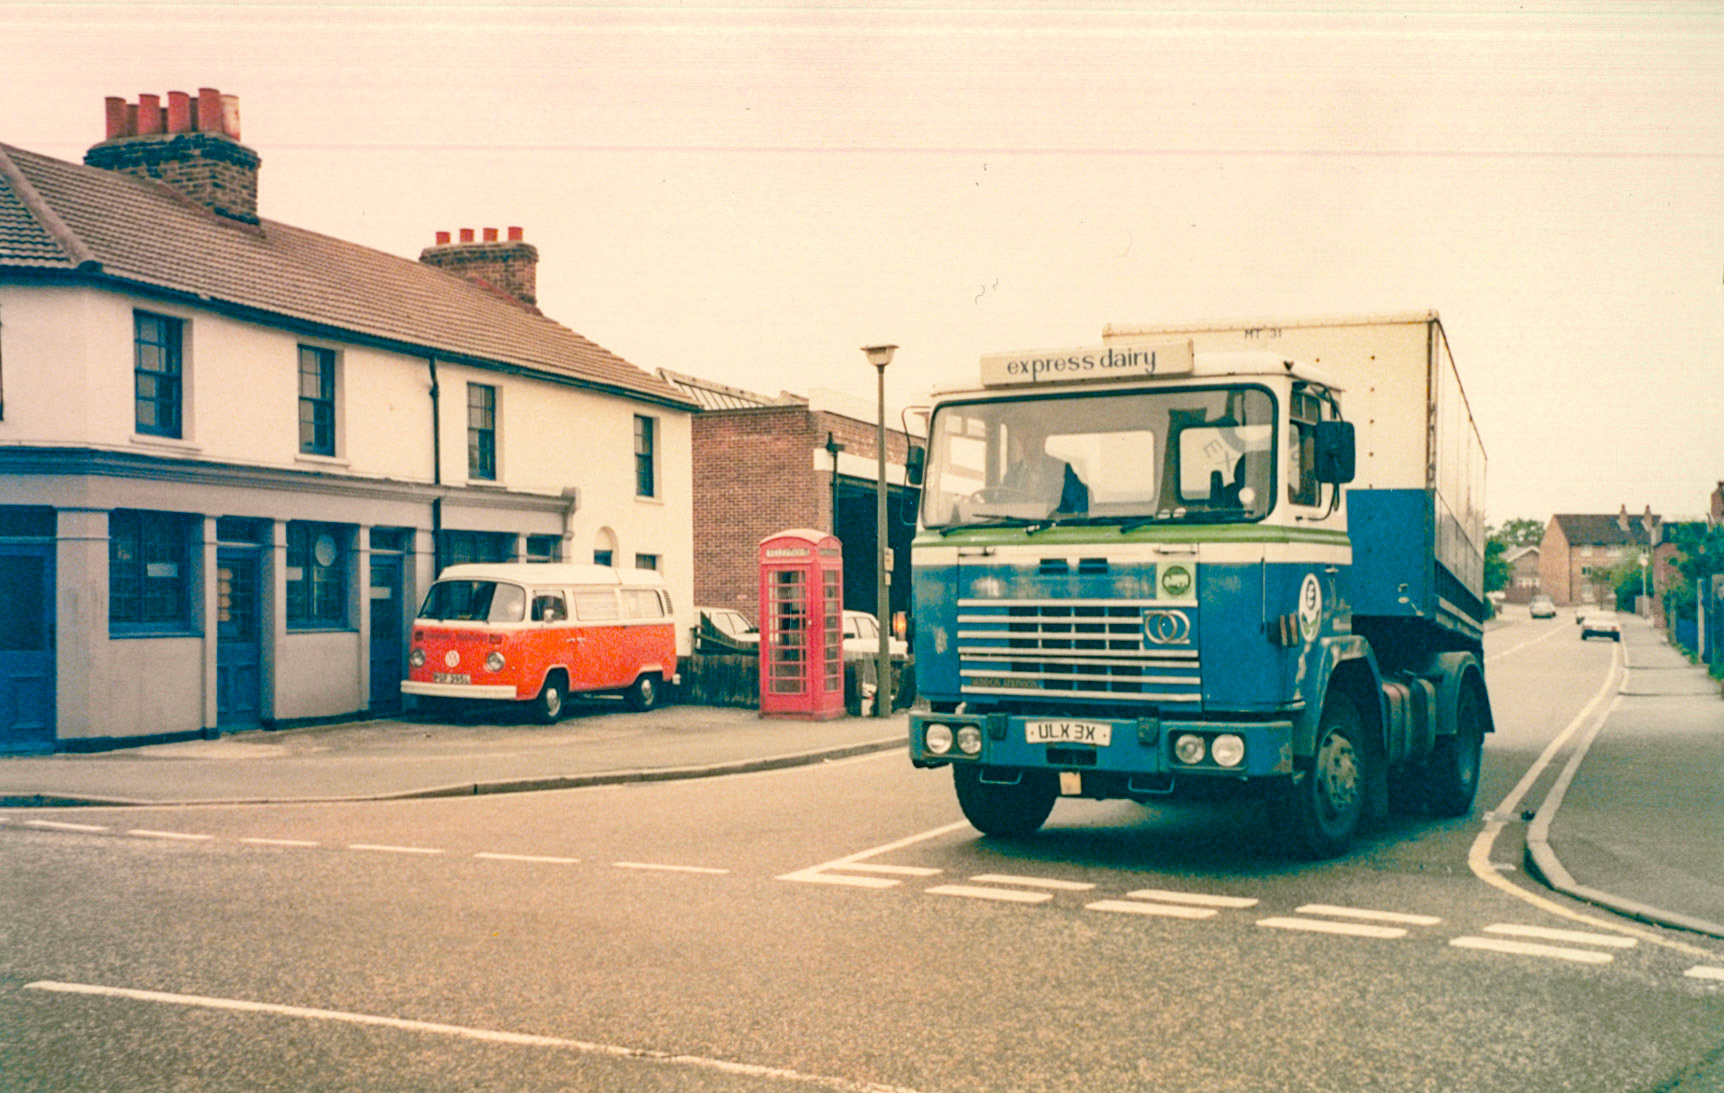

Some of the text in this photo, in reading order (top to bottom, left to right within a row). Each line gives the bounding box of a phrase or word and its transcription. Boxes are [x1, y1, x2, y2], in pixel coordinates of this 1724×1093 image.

[1007, 347, 1157, 382] express dairy
[1038, 724, 1096, 740] ULX 3X
